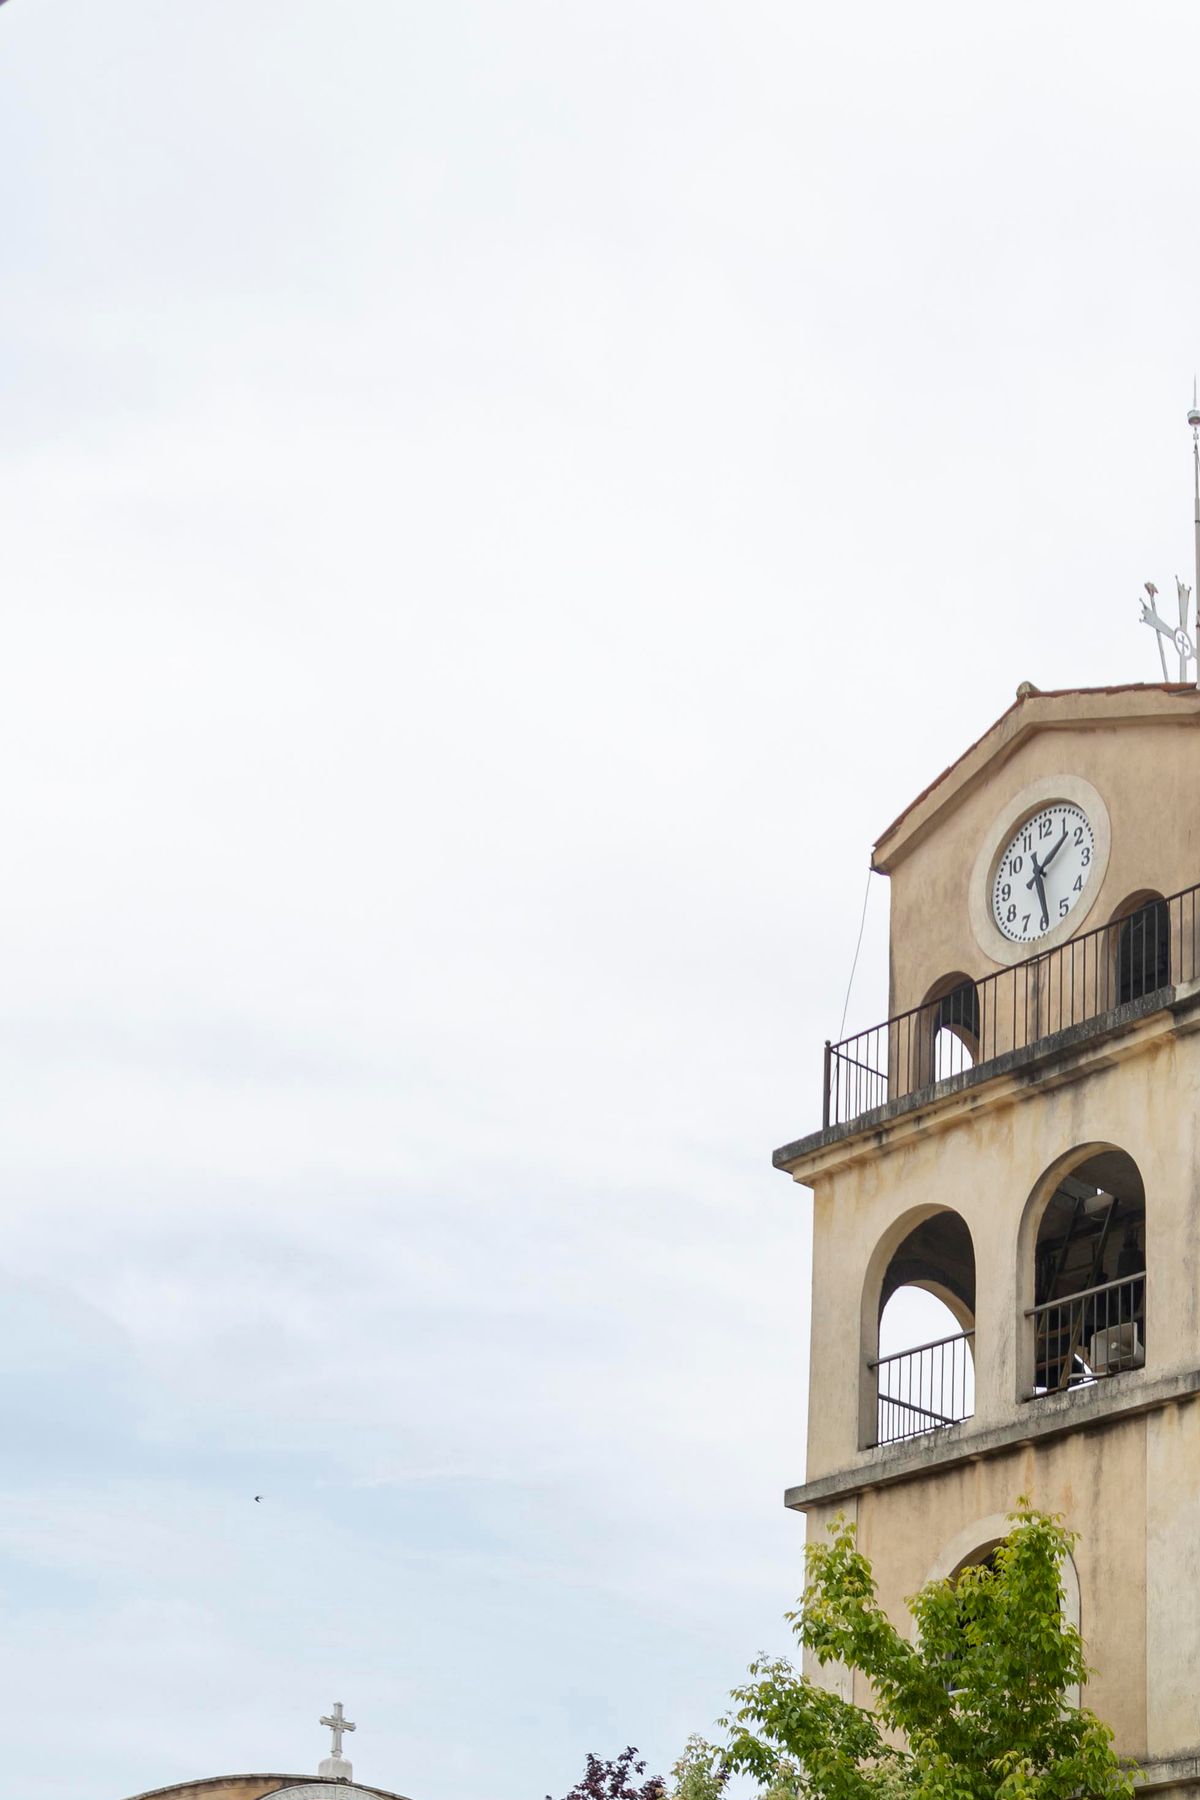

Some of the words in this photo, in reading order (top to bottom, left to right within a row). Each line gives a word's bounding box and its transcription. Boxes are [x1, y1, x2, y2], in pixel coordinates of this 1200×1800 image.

[1038, 818, 1052, 840] 12
[1074, 827, 1083, 846] 2
[1023, 834, 1032, 853] 11
[1009, 856, 1023, 876] 10
[1081, 848, 1090, 866] 3
[1002, 884, 1011, 901] 9
[1072, 874, 1083, 892] 4
[1006, 904, 1016, 922] 8
[1059, 897, 1070, 917] 5
[1022, 914, 1031, 933] 7
[1040, 915, 1049, 932] 6
